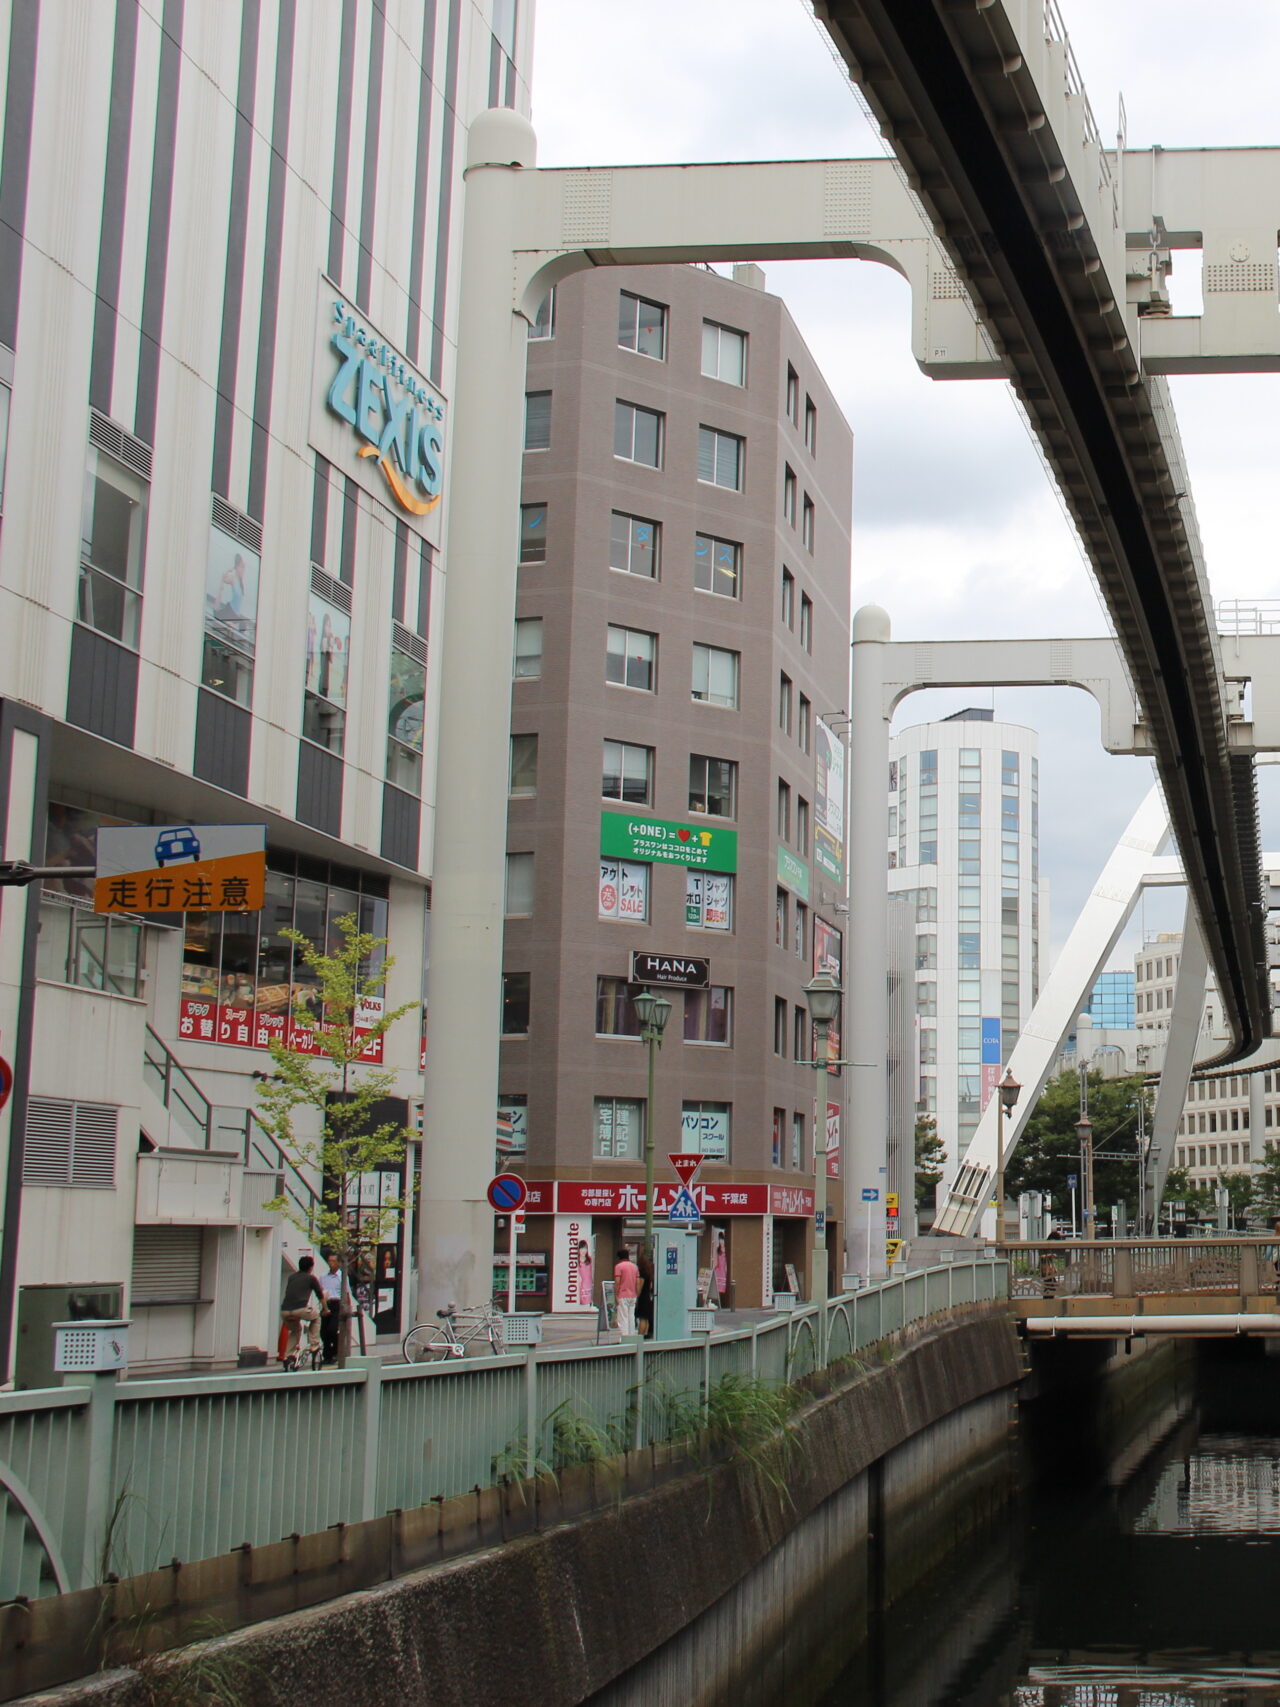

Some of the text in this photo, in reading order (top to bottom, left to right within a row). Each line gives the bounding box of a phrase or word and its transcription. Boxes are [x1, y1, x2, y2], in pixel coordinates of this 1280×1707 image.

[328, 332, 443, 496] ZEXIS
[107, 876, 251, 909] 走行注意
[620, 898, 643, 913] SALE
[359, 997, 382, 1011] VOLKS
[682, 1115, 719, 1130] パソコン
[702, 1132, 725, 1141] スクール
[674, 1159, 697, 1168] 止まれ
[581, 1188, 616, 1198] お部屋探し
[721, 1192, 749, 1205] 千葉店
[584, 1198, 612, 1207] の専門店
[564, 1222, 580, 1304] Homemate
